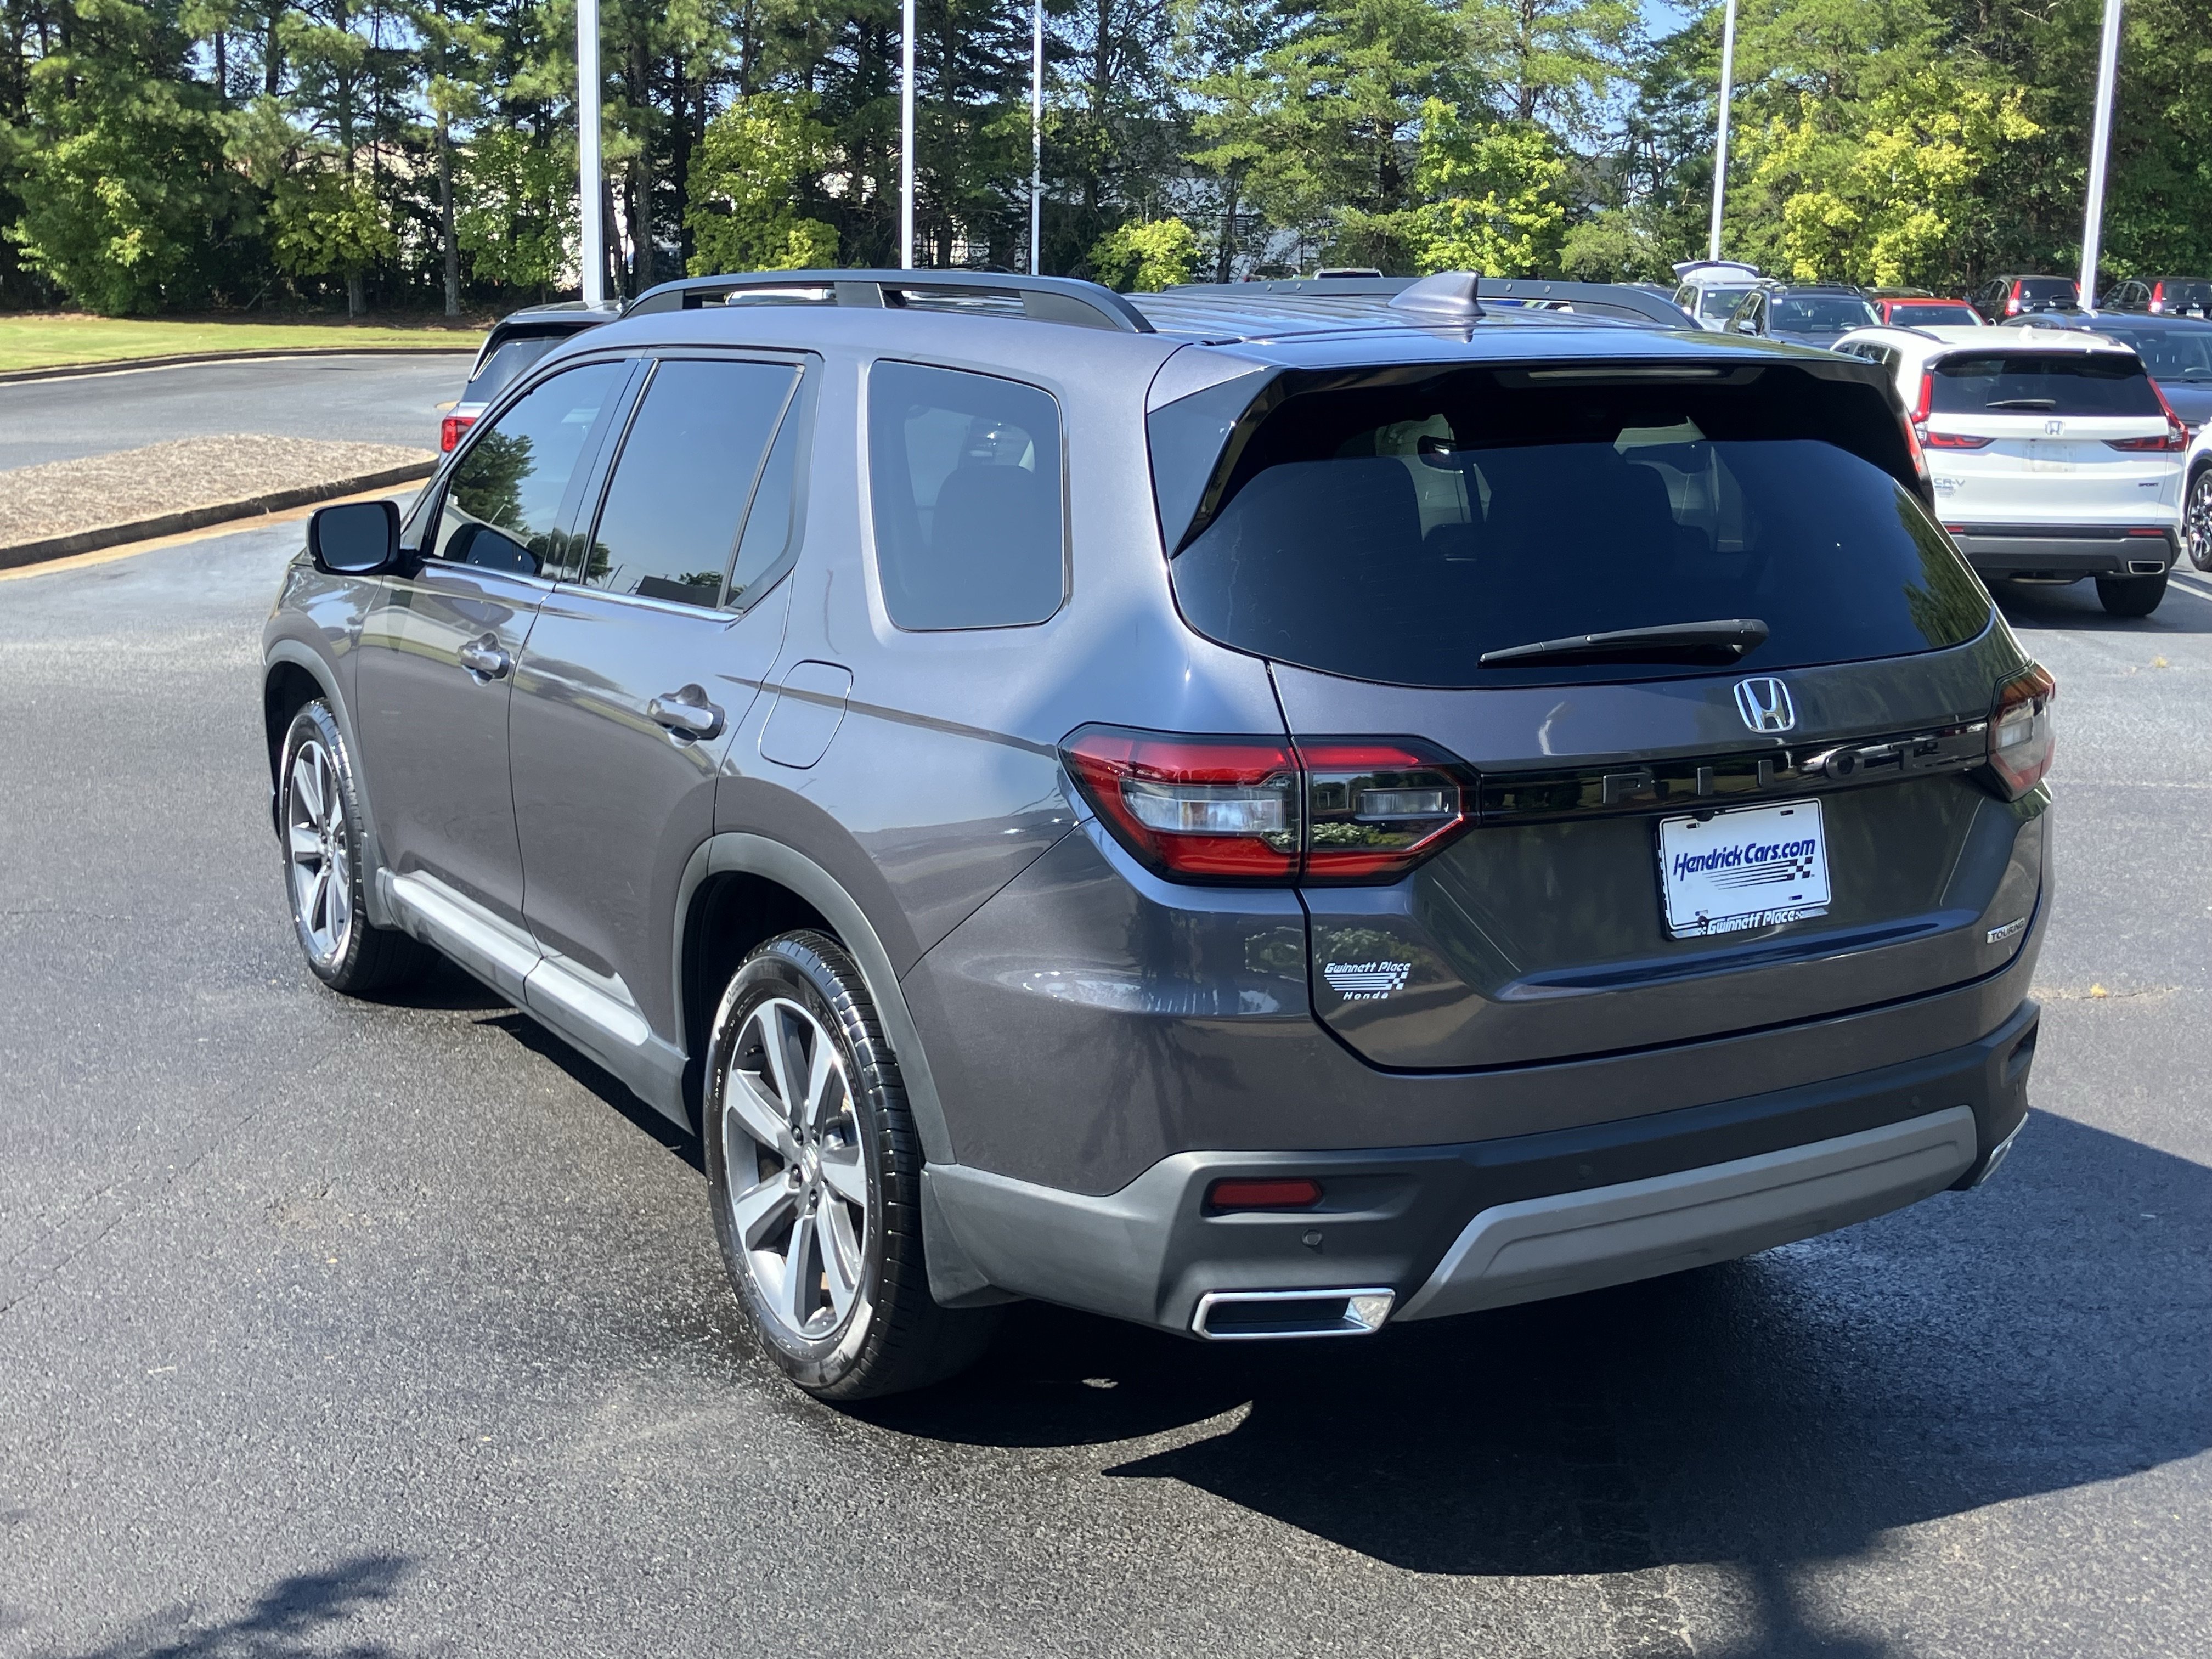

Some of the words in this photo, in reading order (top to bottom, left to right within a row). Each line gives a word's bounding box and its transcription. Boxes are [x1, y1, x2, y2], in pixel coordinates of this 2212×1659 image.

[1933, 477, 1966, 487] CR-V
[1602, 738, 1939, 805] PILOT
[1707, 912, 1763, 935] Gwinnett
[1762, 910, 1795, 926] Place
[1991, 920, 2024, 941] TOURING
[1324, 962, 1376, 973] Gwinnett
[1378, 961, 1411, 972] Place
[1343, 991, 1389, 1000] Honda
